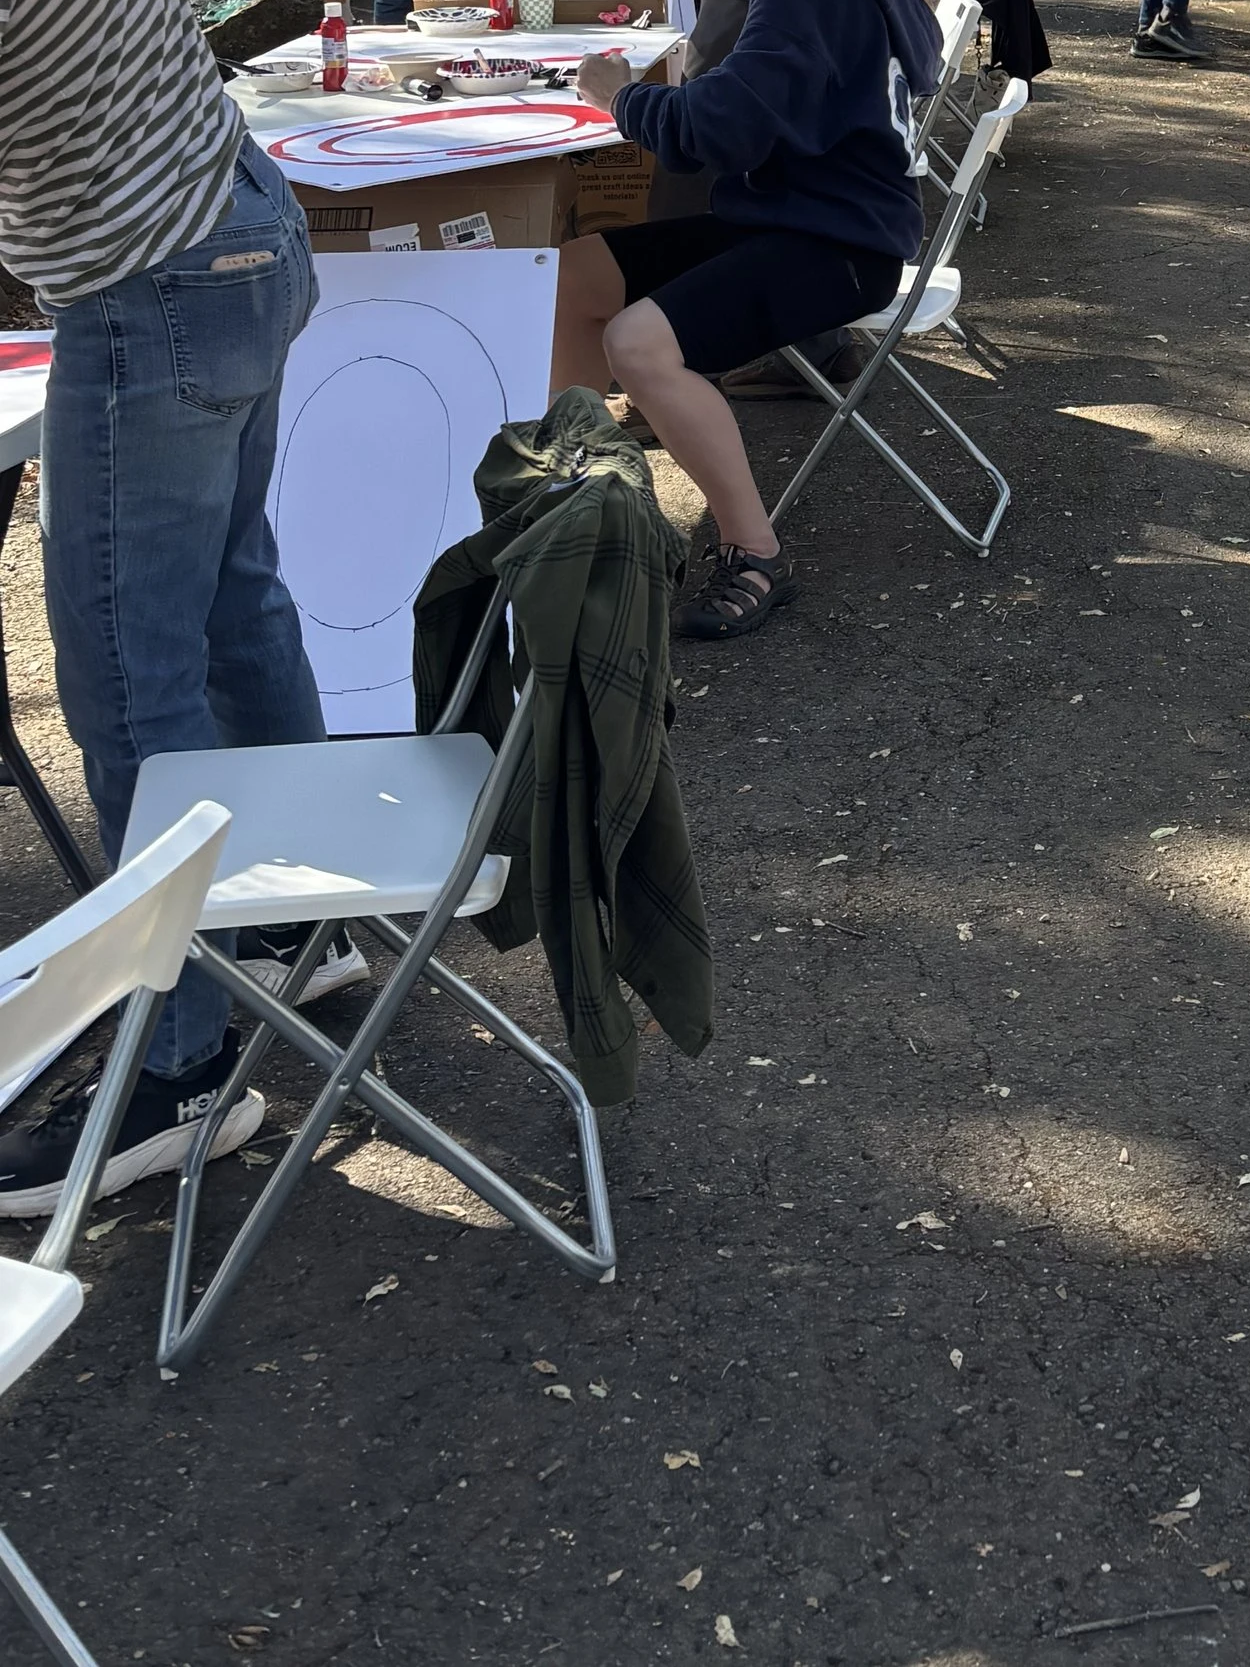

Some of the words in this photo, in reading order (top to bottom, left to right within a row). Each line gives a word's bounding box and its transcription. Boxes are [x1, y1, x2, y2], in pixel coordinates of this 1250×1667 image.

[577, 174, 600, 182] Check
[581, 184, 601, 192] great
[177, 1088, 218, 1124] HO
